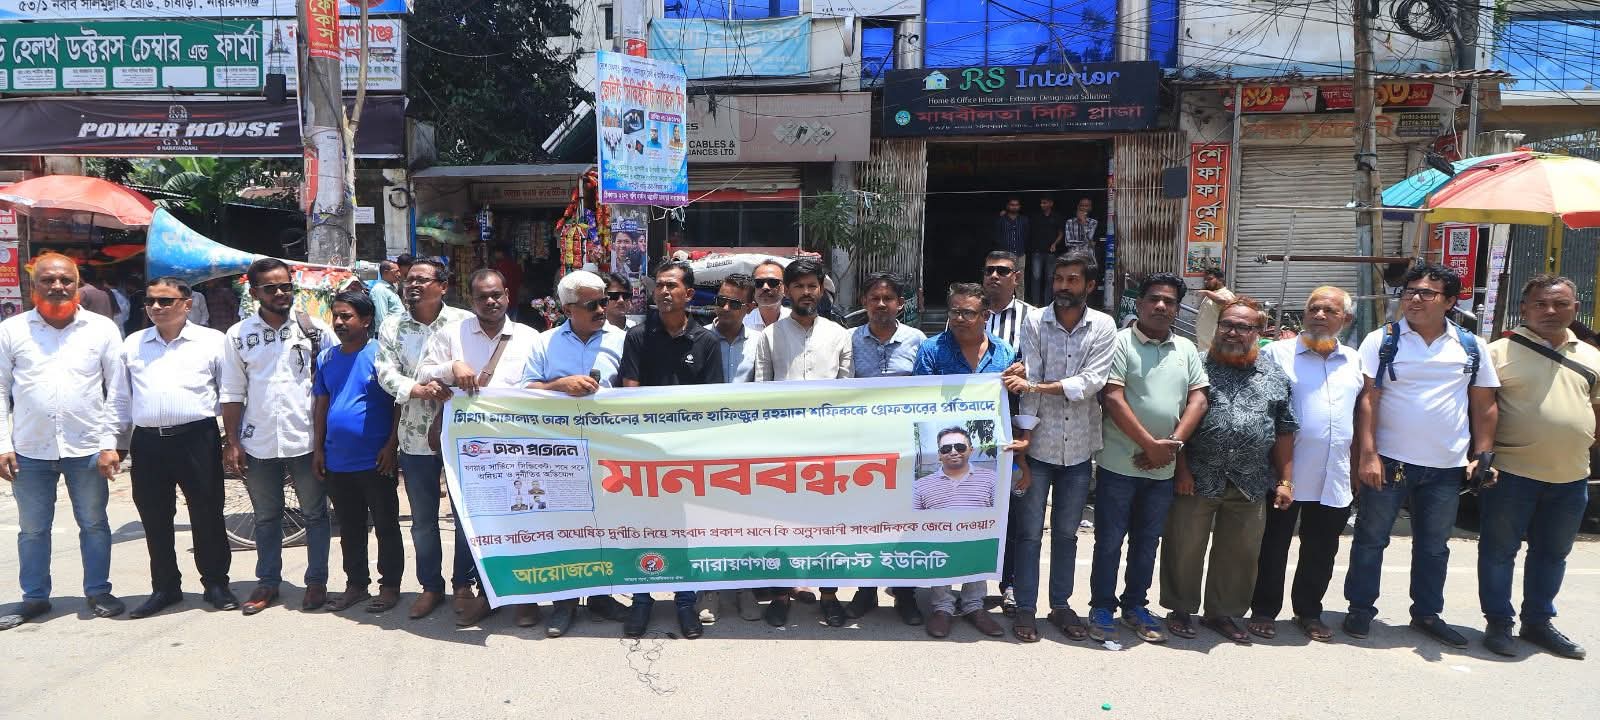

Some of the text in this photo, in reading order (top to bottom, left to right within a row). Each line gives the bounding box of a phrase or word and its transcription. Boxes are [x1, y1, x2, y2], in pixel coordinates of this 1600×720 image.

[13, 33, 60, 65] হেলথ
[64, 26, 127, 64] ডক্টরস
[132, 32, 183, 62] চেম্বার
[214, 24, 260, 61] ফার্মা
[960, 66, 1121, 93] RS Interior
[915, 104, 1144, 122] মাধবীলতা সিটি প্লাজা
[928, 97, 949, 105] Home
[957, 96, 977, 104] Office
[1039, 94, 1065, 102] Design
[78, 122, 283, 138] POWER HOUSE
[454, 409, 485, 424] মিথ্যা
[573, 411, 639, 426] প্রতিদিনের
[643, 408, 703, 424] সাংবাদিক
[707, 407, 758, 424] হাফিজুর
[762, 406, 806, 420] রহমান
[810, 403, 867, 418] শফিককে
[871, 401, 937, 415] গ্রেফতারের
[940, 399, 996, 414] প্রতিবাদে
[493, 443, 579, 457] ঢাকা প্রতিদিন
[597, 453, 900, 497] মানববন্ধন
[505, 530, 554, 545] সার্ভিসের
[557, 526, 604, 540] অঘোষিত
[643, 527, 667, 539] নিয়ে
[671, 527, 705, 538] সংবাদ
[709, 526, 744, 538] প্রকাশ
[746, 527, 772, 537] মানে
[774, 525, 789, 537] কি
[793, 524, 846, 540] অনুসন্ধানী
[850, 521, 918, 535] সাংবাদিককে
[922, 521, 953, 532] জেলে
[955, 518, 996, 531] দেওয়া?
[512, 550, 950, 585] আয়োজনেঃ নারায়ণগঞ্জ জার্নালিস্ট ইউনিটি
